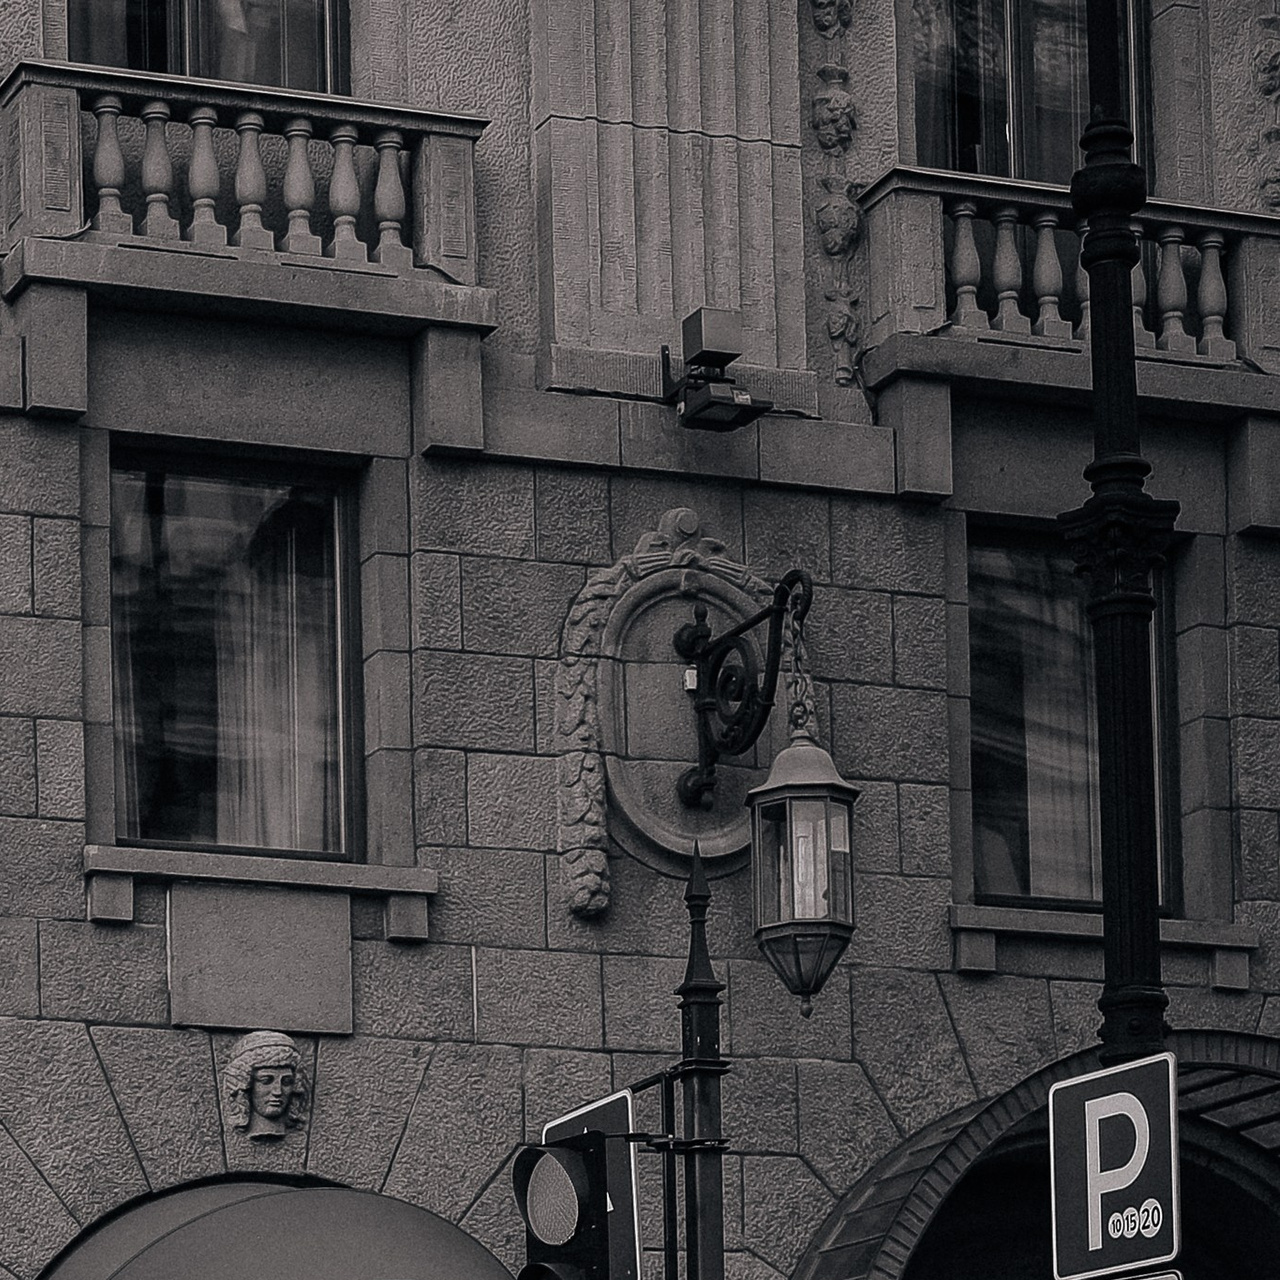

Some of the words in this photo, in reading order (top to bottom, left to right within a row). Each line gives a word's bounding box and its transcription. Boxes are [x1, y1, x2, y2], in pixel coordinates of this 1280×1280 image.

[1084, 1092, 1150, 1251] P
[1111, 1218, 1122, 1234] 10
[1125, 1213, 1137, 1232] 15
[1141, 1205, 1161, 1231] 20
